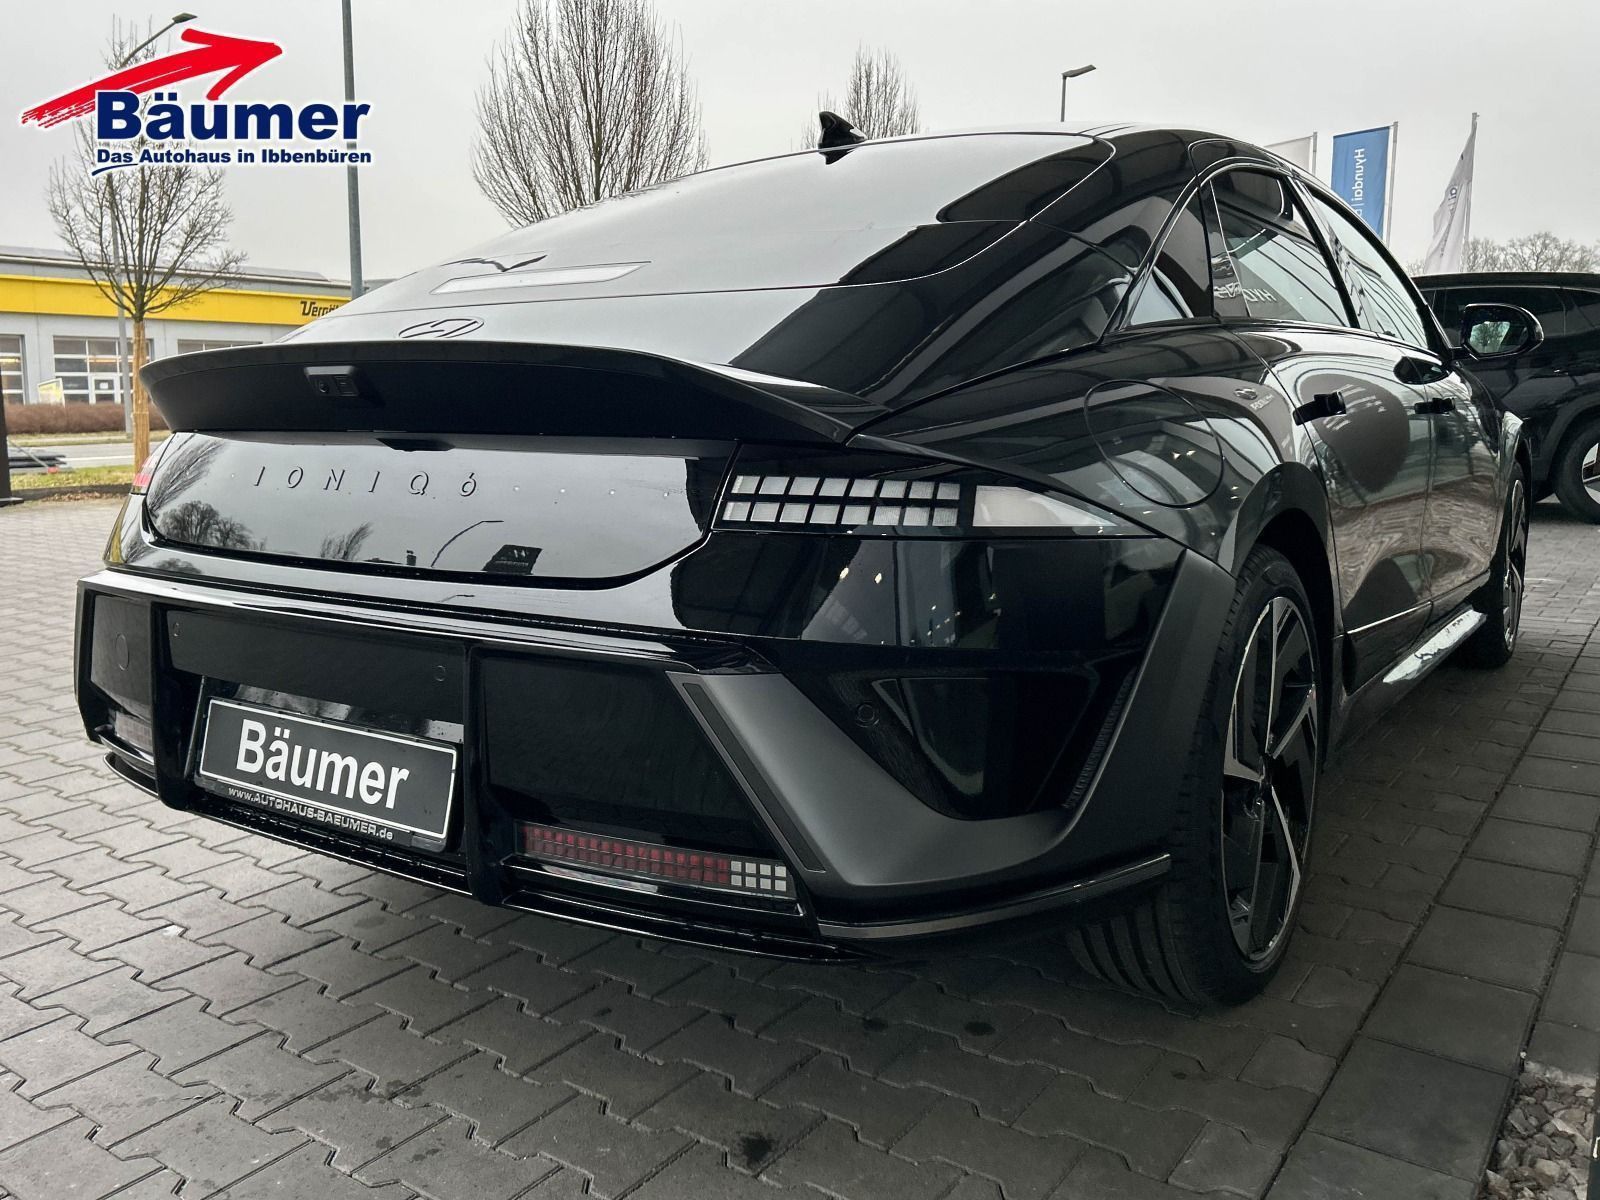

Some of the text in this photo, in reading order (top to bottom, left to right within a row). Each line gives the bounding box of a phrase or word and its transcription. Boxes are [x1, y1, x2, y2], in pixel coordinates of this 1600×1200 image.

[253, 465, 430, 496] IONIQ
[236, 718, 410, 810] Bäumer
[227, 786, 394, 841] www.AUTOHAUS-BAEUMER.de
